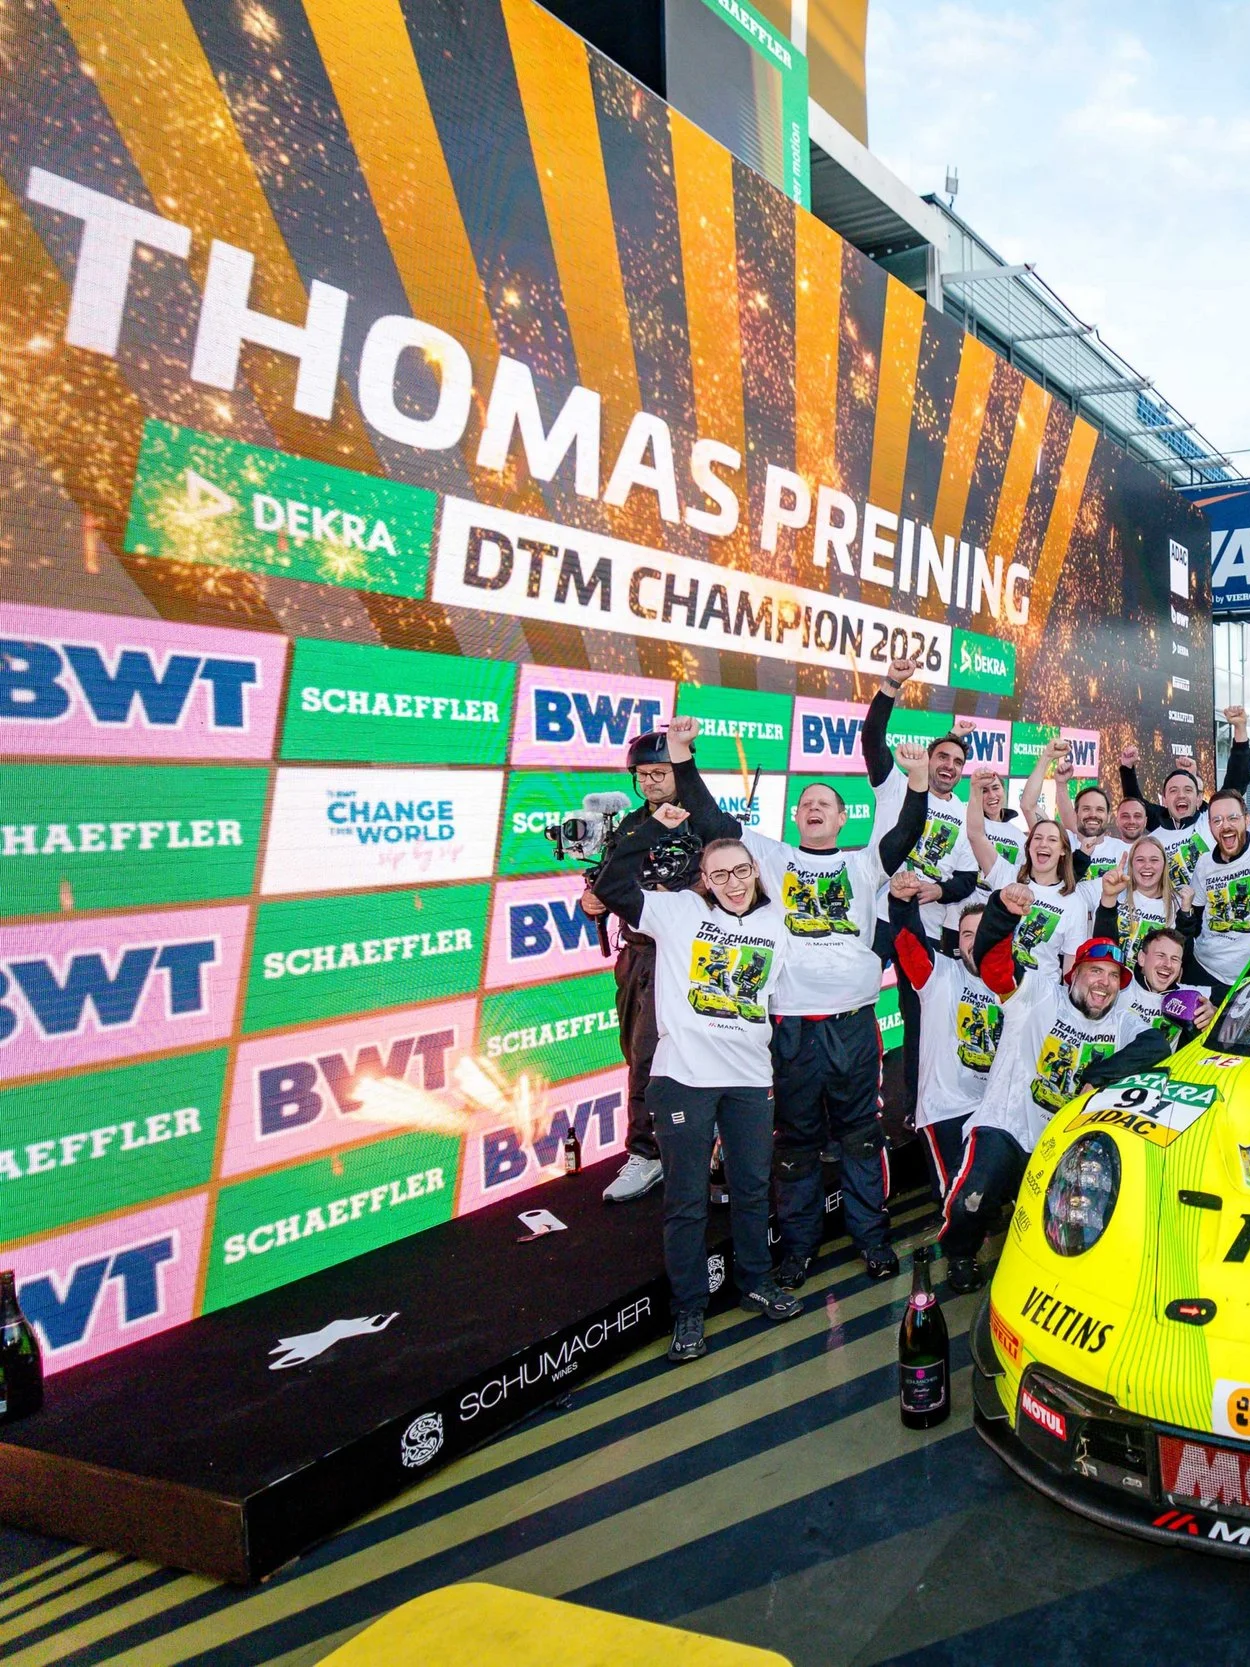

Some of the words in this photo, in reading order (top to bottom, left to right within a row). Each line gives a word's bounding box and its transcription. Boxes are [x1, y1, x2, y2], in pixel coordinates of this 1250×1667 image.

[791, 121, 801, 178] motion
[26, 166, 741, 537] THOMAS
[761, 463, 1030, 626] PREINING
[253, 494, 398, 557] DEKRA
[1171, 542, 1188, 567] ADAC
[462, 524, 612, 613] DTM
[628, 566, 864, 665] CHAMPION
[870, 621, 942, 672] 2026
[0, 637, 256, 729] BWT
[974, 652, 1008, 677] DEKRA
[300, 686, 501, 725] SCHAEFFLER
[534, 689, 662, 748] BWT
[697, 717, 784, 741] CHAEFFLER
[326, 799, 455, 824] CHANGE
[356, 824, 456, 845] WORLD
[509, 900, 601, 960] BW
[1031, 899, 1065, 916] AMPION
[1135, 908, 1166, 924] CHAMPIO
[263, 928, 472, 980] SCHAEFFLER
[695, 930, 719, 944] DTM
[0, 938, 217, 1041] WT
[486, 1007, 620, 1058] SCHAEFFLE
[1050, 1027, 1067, 1042] DTM
[259, 1028, 456, 1137] BWT
[1113, 1086, 1175, 1122] 91
[1117, 1071, 1214, 1106] DEKRA
[483, 1091, 623, 1190] BWT
[1086, 1109, 1158, 1137] ADAC
[223, 1166, 445, 1265] SCHAEFFLER
[17, 1235, 174, 1351] WT
[1019, 1285, 1116, 1355] VELTINS
[459, 1296, 653, 1422] SCHUMACHER
[551, 1361, 579, 1383] WINES
[1022, 1391, 1062, 1436] MOTUL
